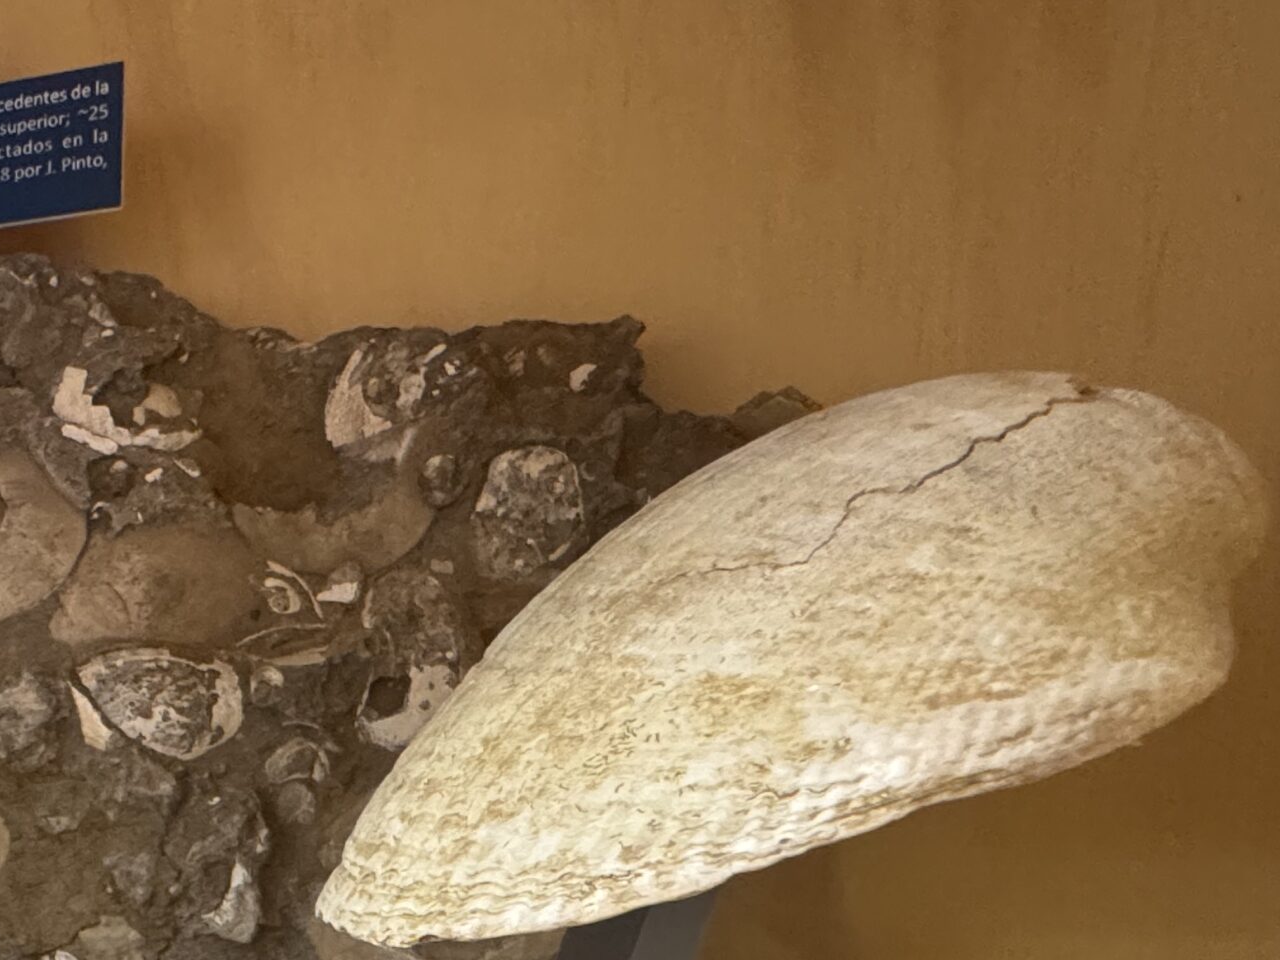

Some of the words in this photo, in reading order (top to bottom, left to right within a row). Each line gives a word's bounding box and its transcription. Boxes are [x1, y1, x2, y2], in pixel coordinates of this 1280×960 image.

[70, 83, 92, 101] de
[95, 80, 110, 96] la
[0, 113, 71, 136] superior;
[78, 103, 109, 122] ~25
[62, 134, 83, 149] en
[93, 128, 109, 144] la
[14, 164, 43, 183] por
[45, 160, 56, 176] J.
[61, 154, 108, 172] Pinto,
